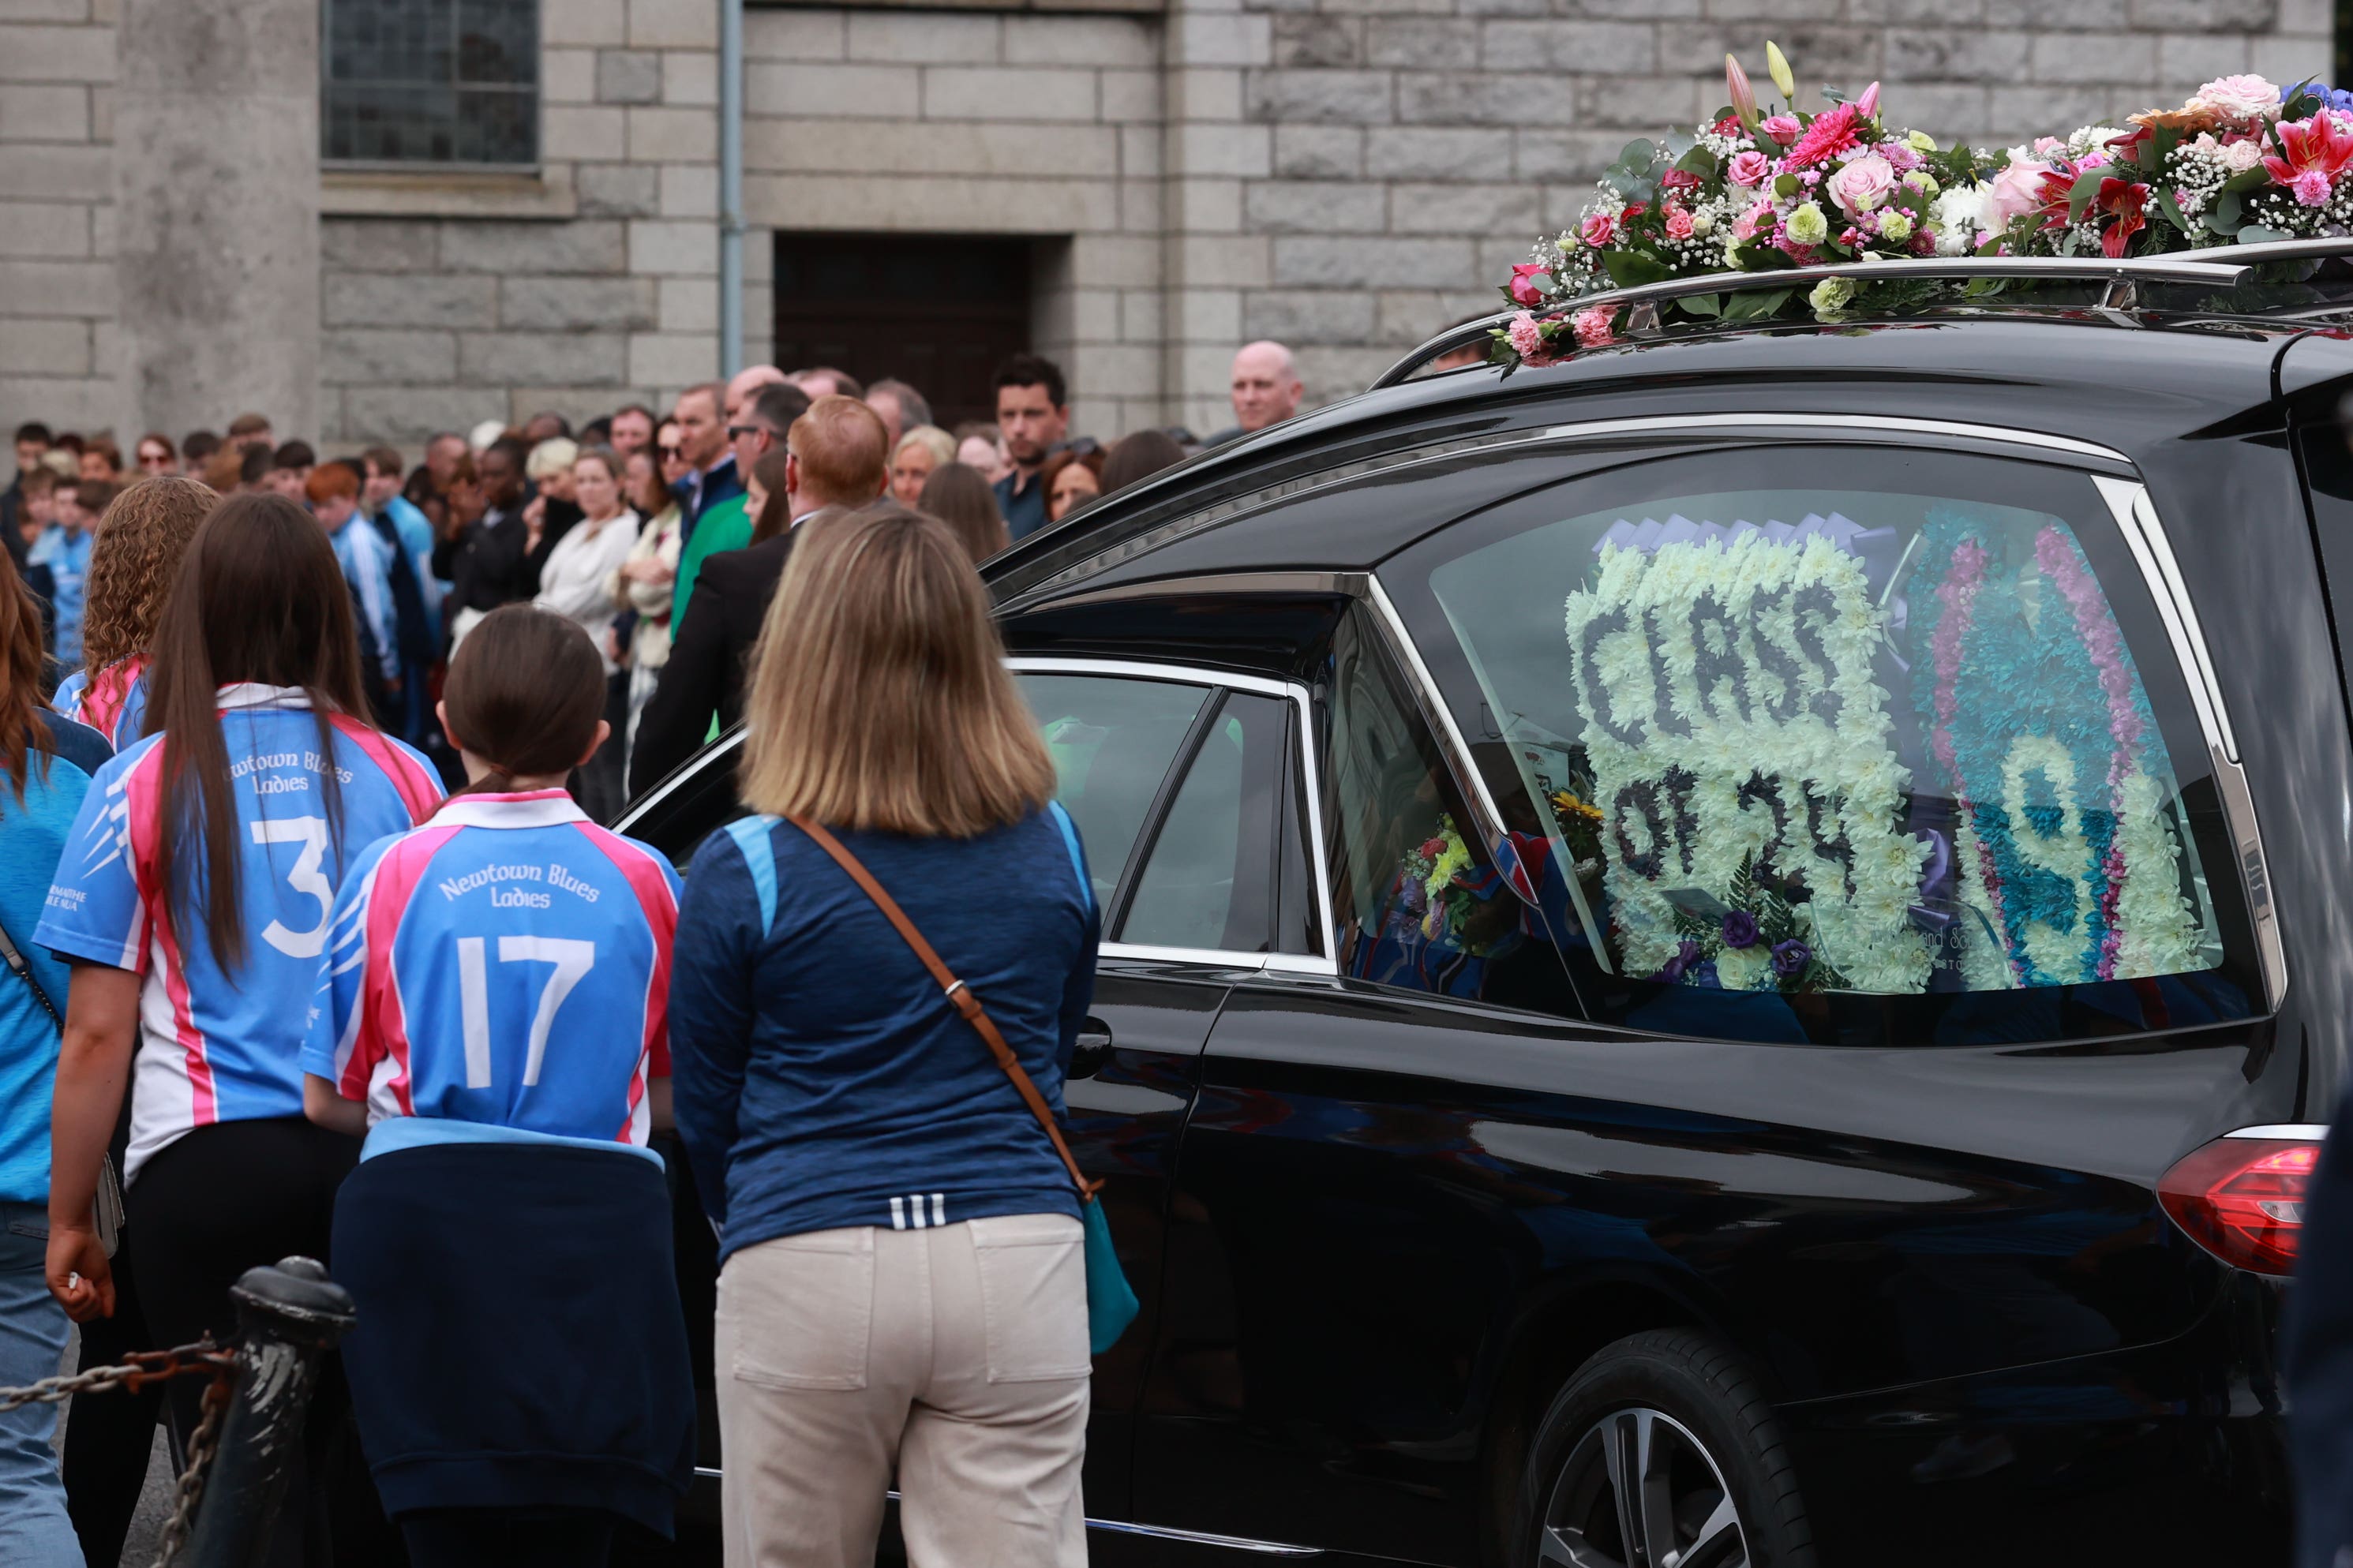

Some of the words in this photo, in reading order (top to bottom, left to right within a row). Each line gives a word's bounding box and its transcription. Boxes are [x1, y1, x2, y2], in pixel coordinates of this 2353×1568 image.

[1581, 585, 1842, 749] CLASS
[224, 752, 299, 780] wtown
[252, 775, 309, 794] Ladies
[1613, 763, 1698, 881] OF
[249, 815, 335, 958] 3
[438, 863, 542, 901] Newtown
[548, 863, 600, 903] Blues
[490, 886, 551, 909] Ladies
[2001, 734, 2095, 985] 9
[457, 935, 595, 1089] 17
